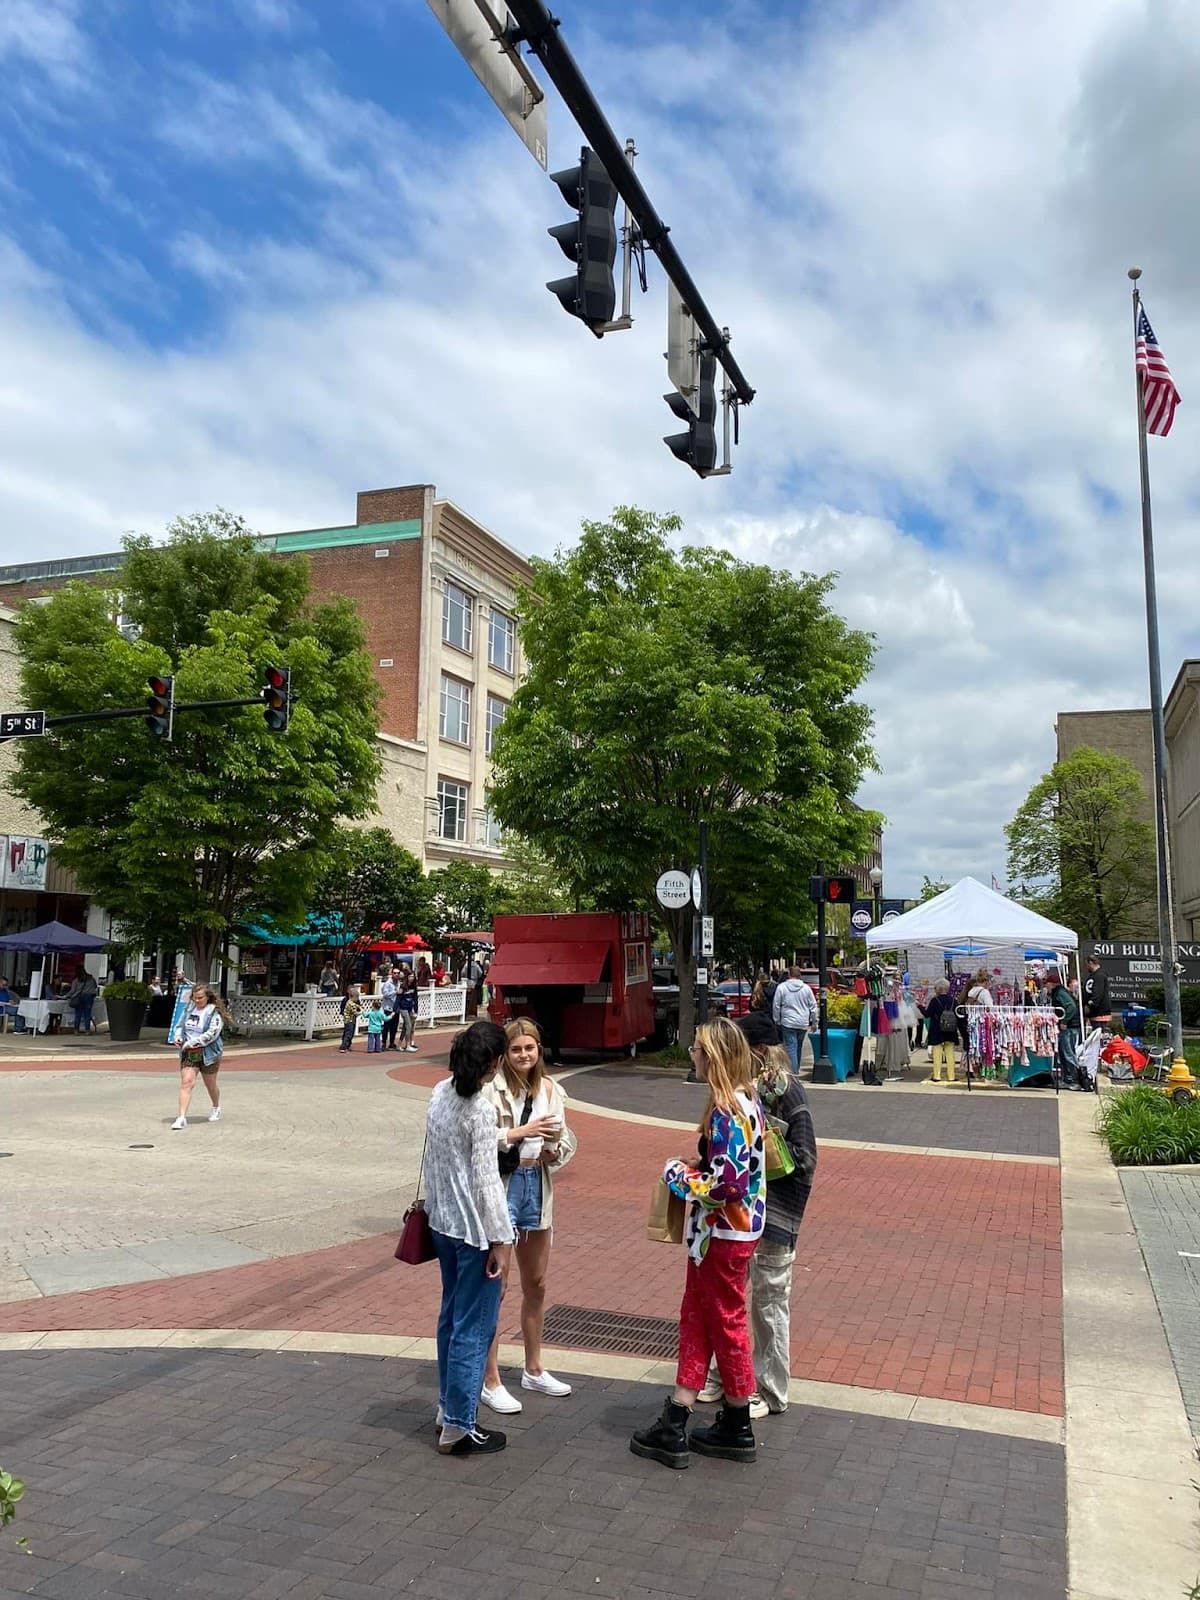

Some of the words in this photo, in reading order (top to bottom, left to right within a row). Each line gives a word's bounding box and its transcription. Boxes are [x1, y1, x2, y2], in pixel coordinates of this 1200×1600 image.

[25, 717, 36, 730] St
[664, 880, 684, 888] Fifth
[662, 890, 686, 898] Street
[1094, 943, 1115, 956] 501
[1122, 944, 1200, 957] BUILNG
